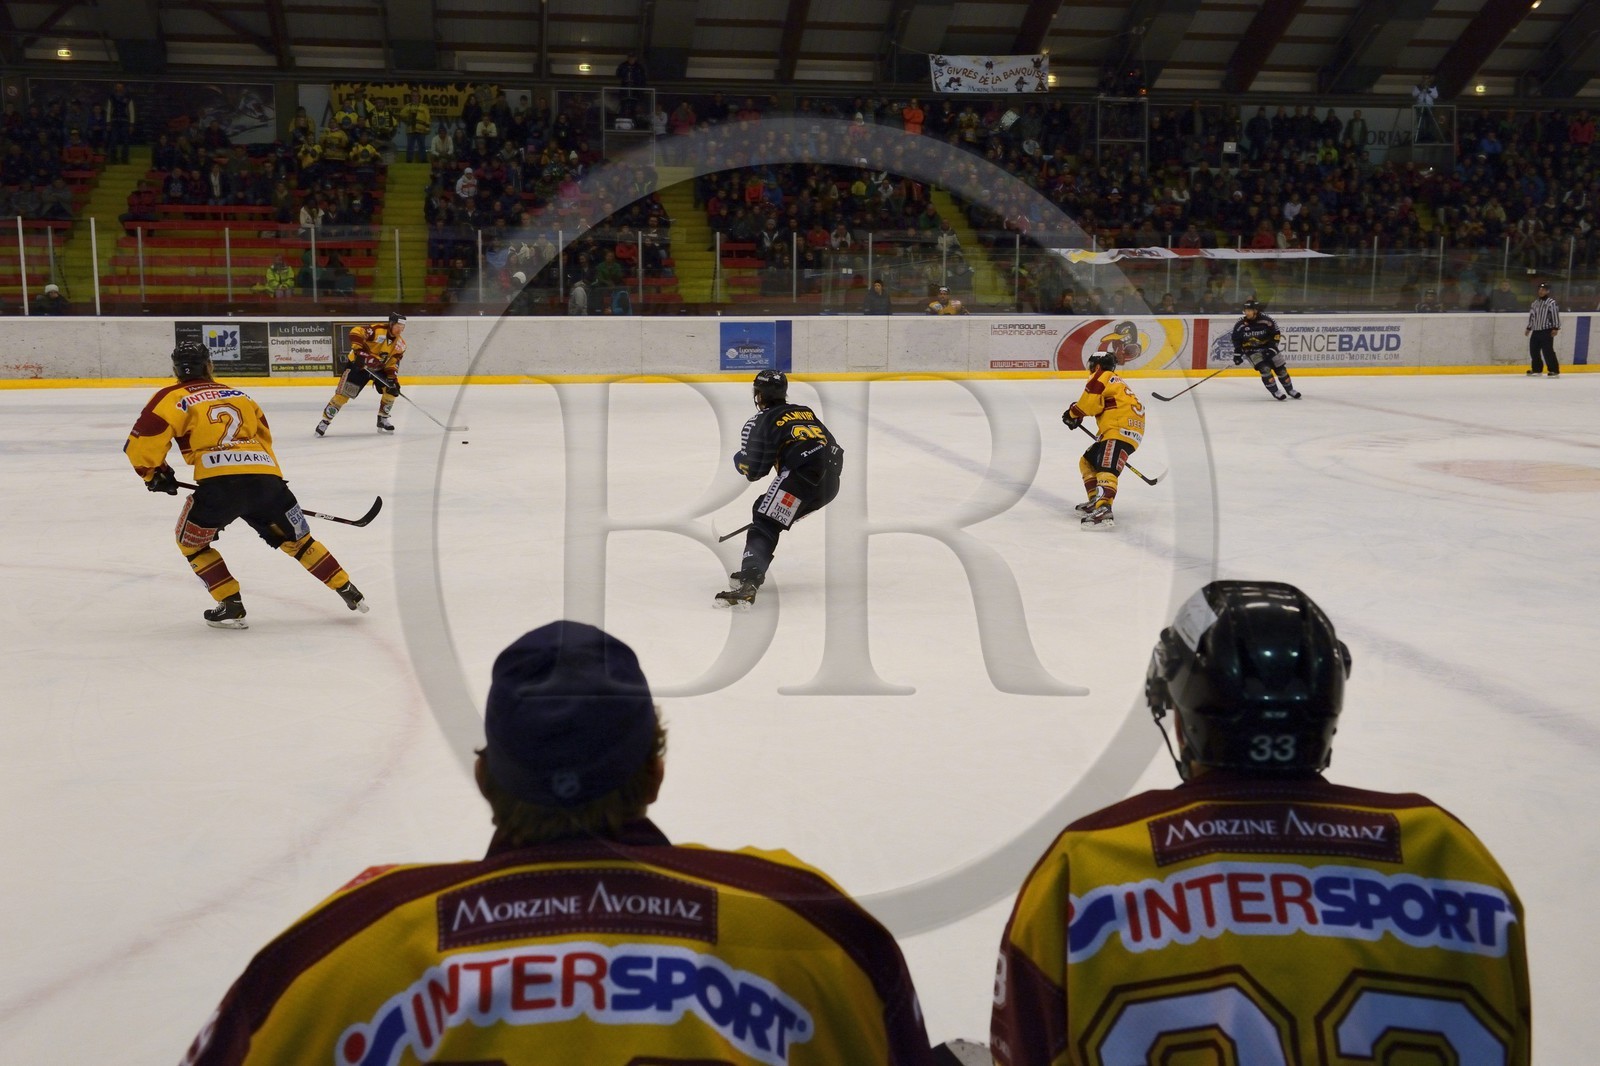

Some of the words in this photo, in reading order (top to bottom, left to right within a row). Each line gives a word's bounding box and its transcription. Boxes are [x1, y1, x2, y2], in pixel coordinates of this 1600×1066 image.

[978, 75, 989, 85] DE
[991, 75, 1002, 85] LA
[1002, 67, 1047, 82] BANQUISE
[291, 325, 325, 335] flambée
[270, 338, 311, 346] Cheminées
[186, 390, 250, 405] INTERSPO
[206, 403, 246, 448] 2
[769, 511, 788, 525] clos
[774, 502, 792, 518] huis
[1249, 734, 1296, 762] 33
[1165, 817, 1278, 847] MORZINE
[1283, 809, 1387, 843] AVORIAZ
[452, 894, 582, 932] MORZINE
[588, 880, 704, 922] AVORIAZ
[1124, 872, 1506, 948] INTERSPORT
[411, 951, 799, 1063] INTERSPORT
